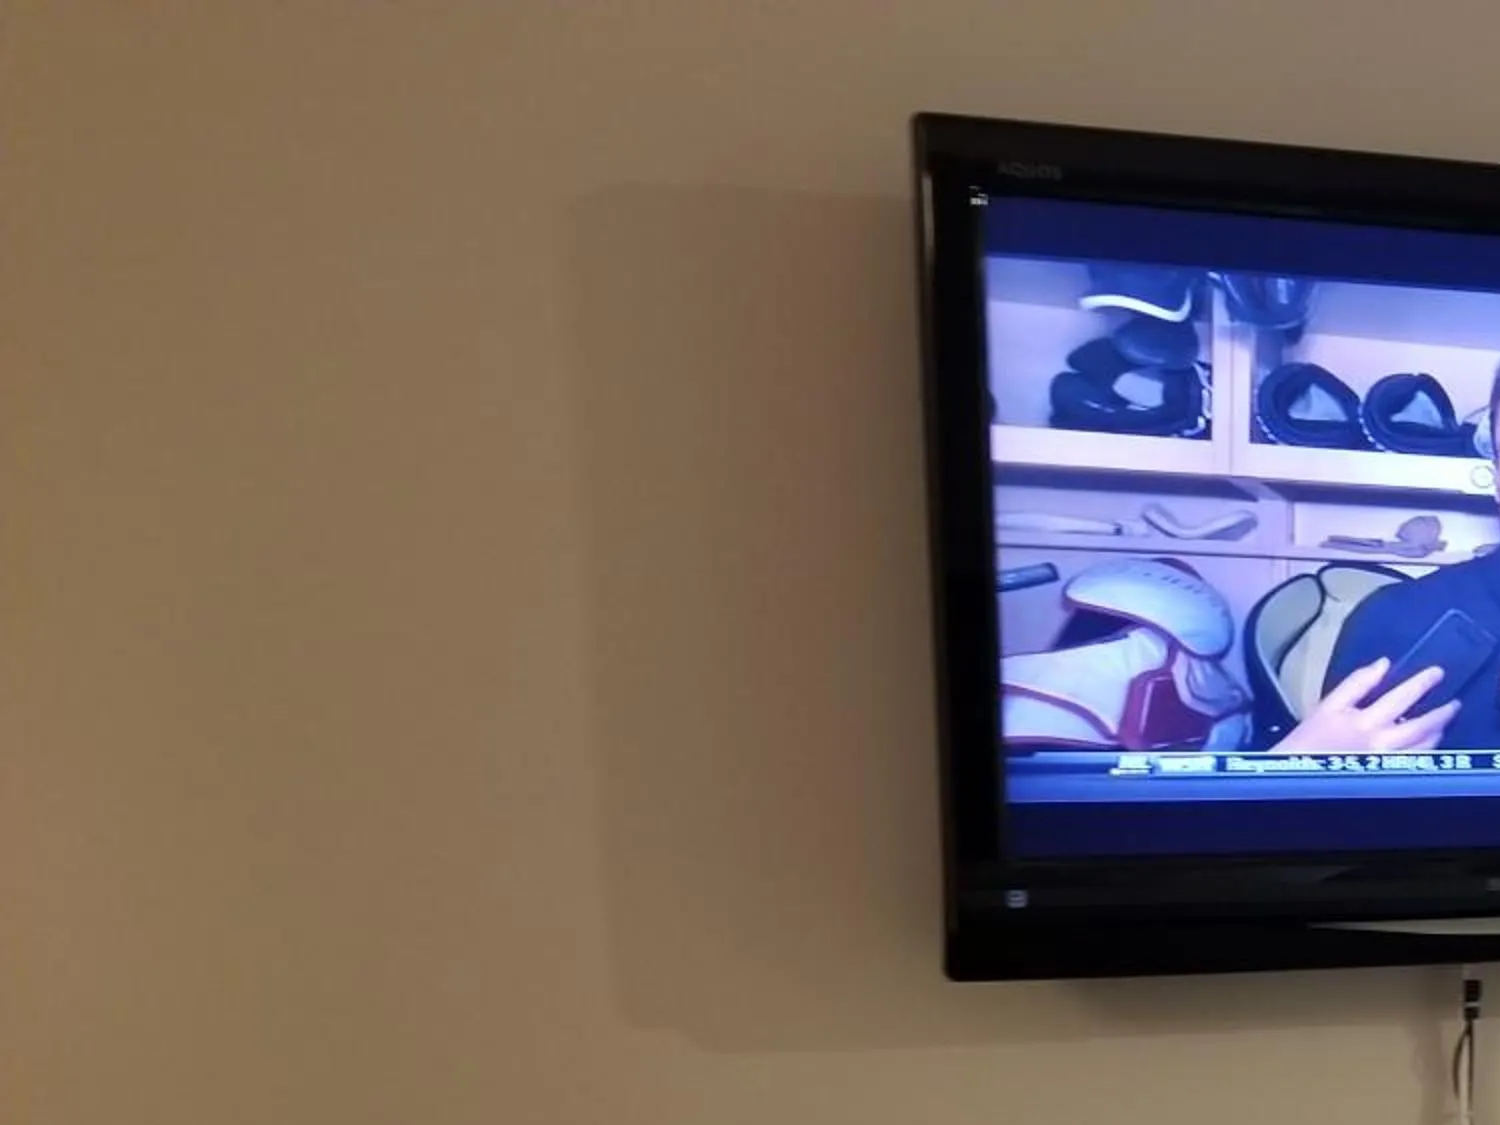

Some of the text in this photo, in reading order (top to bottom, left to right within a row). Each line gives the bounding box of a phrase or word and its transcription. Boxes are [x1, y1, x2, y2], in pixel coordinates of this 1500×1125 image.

[1327, 755, 1364, 772] 3-5,
[1366, 755, 1381, 770] 2
[1440, 755, 1454, 770] 3
[1456, 754, 1472, 769] R
